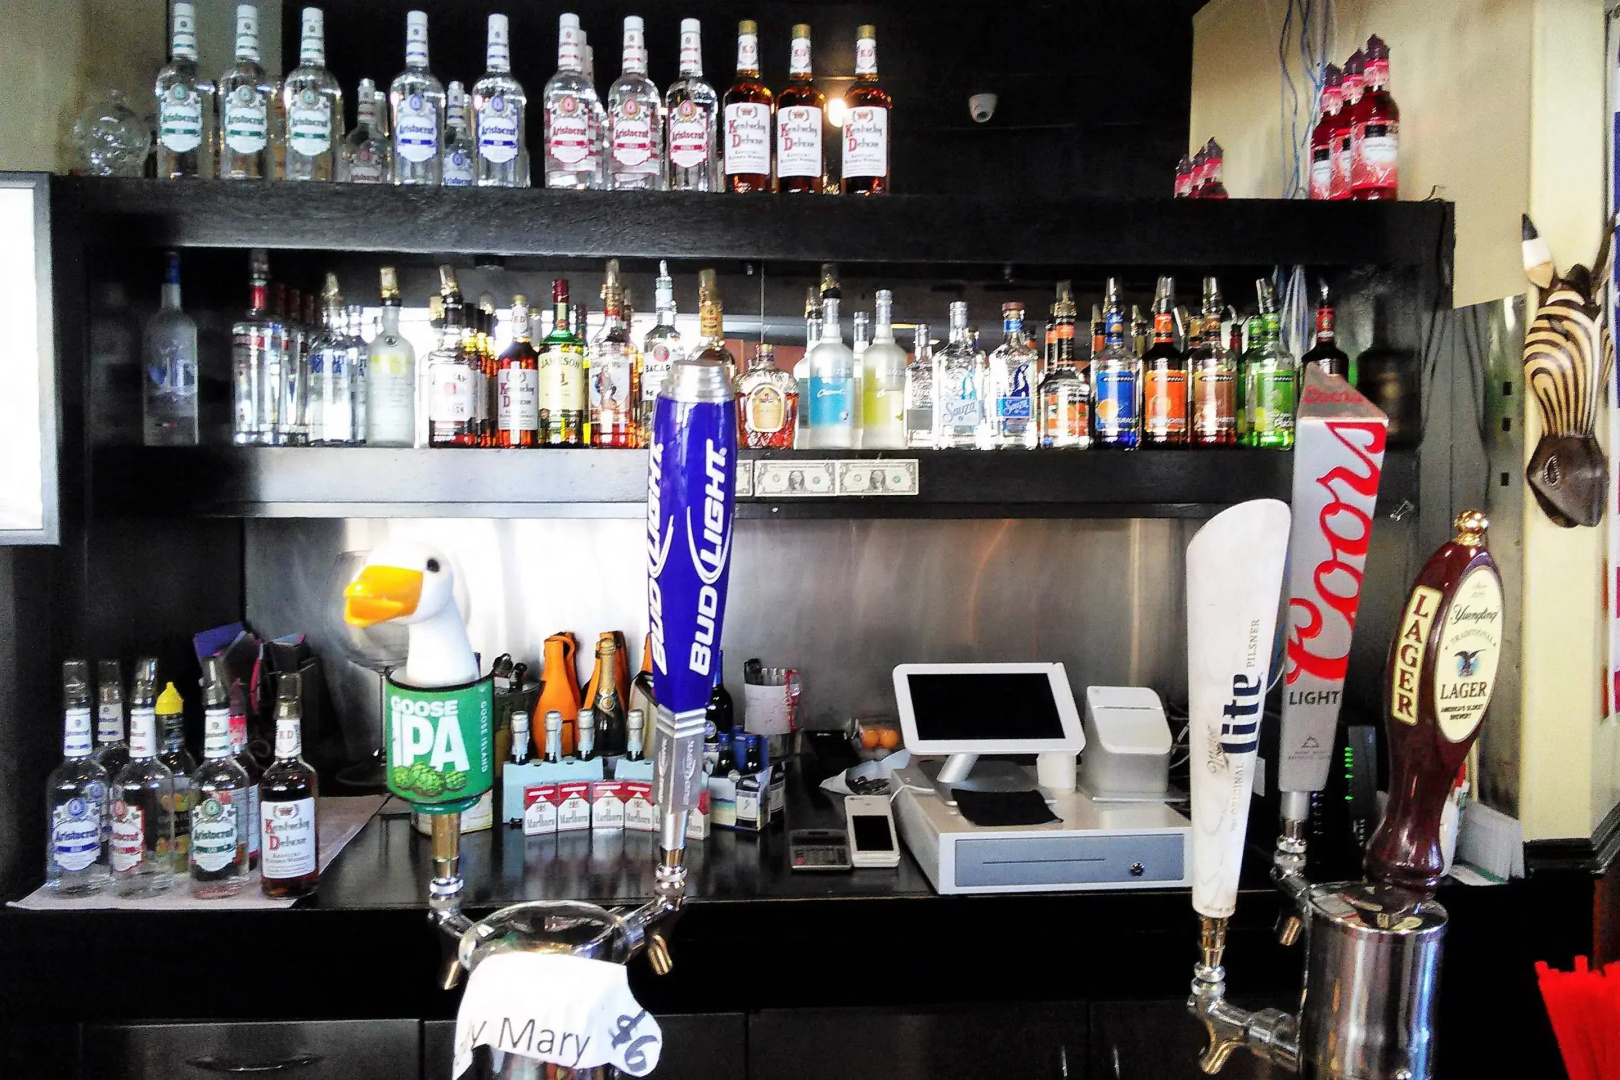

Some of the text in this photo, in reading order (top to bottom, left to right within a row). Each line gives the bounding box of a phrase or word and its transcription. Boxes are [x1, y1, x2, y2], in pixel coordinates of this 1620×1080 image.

[400, 125, 434, 135] Aristocrat
[482, 125, 517, 136] Aristocrat
[552, 126, 587, 136] Aristocrat
[728, 119, 766, 134] Kentucky
[780, 123, 818, 137] Kentucky
[845, 124, 883, 138] Kentucky
[616, 129, 649, 139] Aristocrat
[672, 131, 705, 141] Aristocrat
[732, 134, 763, 148] Deluxe
[784, 137, 815, 151] Deluxe
[848, 138, 880, 152] Deluxe
[645, 364, 671, 373] BACAR
[943, 400, 977, 421] Sauza
[1285, 421, 1388, 686] Coors
[1450, 604, 1499, 625] Yuengling
[689, 584, 718, 676] BUD
[1246, 618, 1261, 668] PILSNER
[1397, 594, 1429, 717] LAGER
[1288, 690, 1341, 706] LIGHT
[1440, 682, 1488, 700] LAGER
[391, 695, 459, 717] GOOSE
[392, 712, 471, 773] IPA
[480, 700, 489, 773] GOOSE ISLAND
[527, 814, 556, 827] Marlboro
[560, 810, 588, 824] Marlboro
[595, 808, 623, 822] Marlboro
[626, 810, 651, 824] Marlboro
[265, 818, 310, 834] Kentucky
[269, 836, 307, 851] Deluxe
[498, 1017, 591, 1068] Mary
